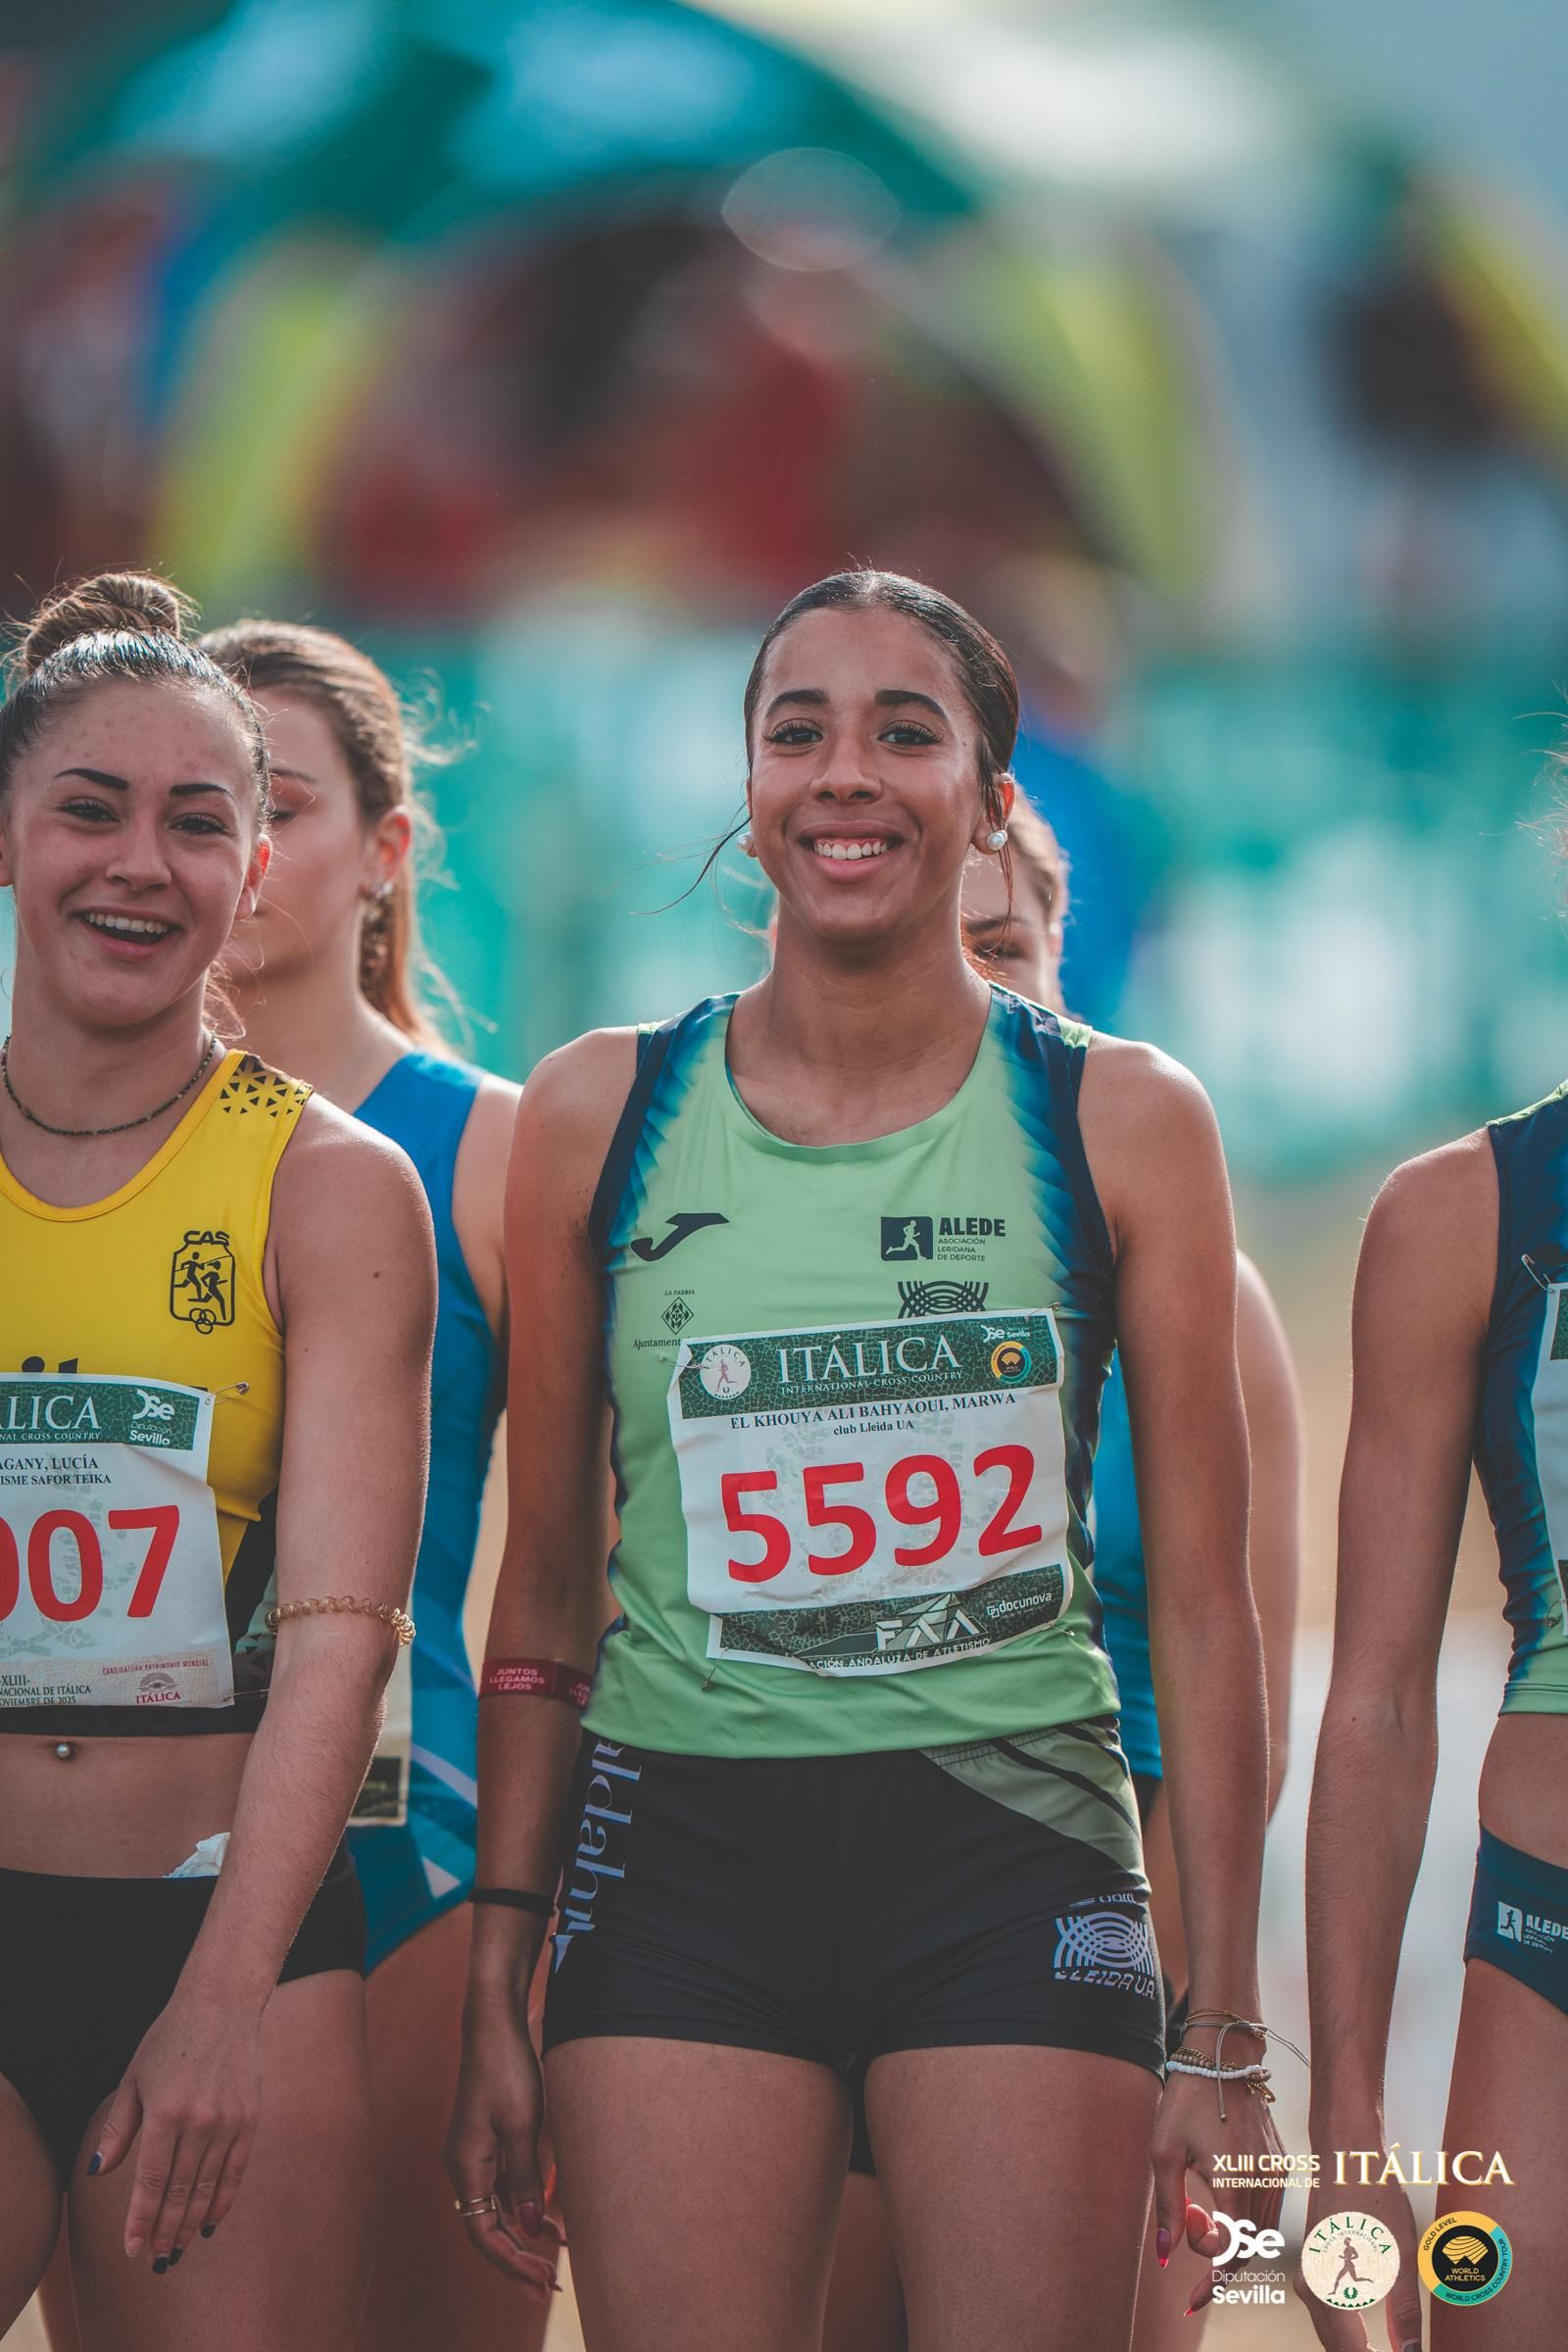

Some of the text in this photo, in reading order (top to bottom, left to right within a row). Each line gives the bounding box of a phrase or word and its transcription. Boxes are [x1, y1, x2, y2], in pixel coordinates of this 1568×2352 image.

[939, 1217, 1005, 1237] ALEDE
[184, 1230, 229, 1247] CAS
[633, 1339, 682, 1350] Ajuntament
[776, 1335, 962, 1384] ITÁLICA
[780, 1370, 964, 1396] INTERNATIONAL CROSS COUNTRY
[0, 1396, 102, 1430] LICA
[730, 1393, 1016, 1430] EL KHOUYA ALI BAHYAOUI, MARWA
[833, 1419, 914, 1436] club Lleida UA
[22, 1432, 51, 1441] CROSS
[55, 1432, 102, 1441] COUNTRY
[129, 1429, 171, 1446] Sevilla
[52, 1454, 98, 1470] LUCÍA
[31, 1474, 72, 1486] SAFOR
[74, 1474, 112, 1485] TEIKA
[720, 1445, 1043, 1584] 5592
[0, 1504, 180, 1623] 07
[999, 1592, 1052, 1613] docunova
[849, 1652, 910, 1667] ANDALUZA
[916, 1650, 929, 1661] DE
[933, 1638, 991, 1657] ATLETISMO
[43, 1686, 56, 1696] DE
[58, 1684, 92, 1695] ITÁLICA
[136, 1691, 181, 1704] ITÁLICA
[43, 1696, 56, 1705] DE
[59, 1695, 77, 1705] 2025
